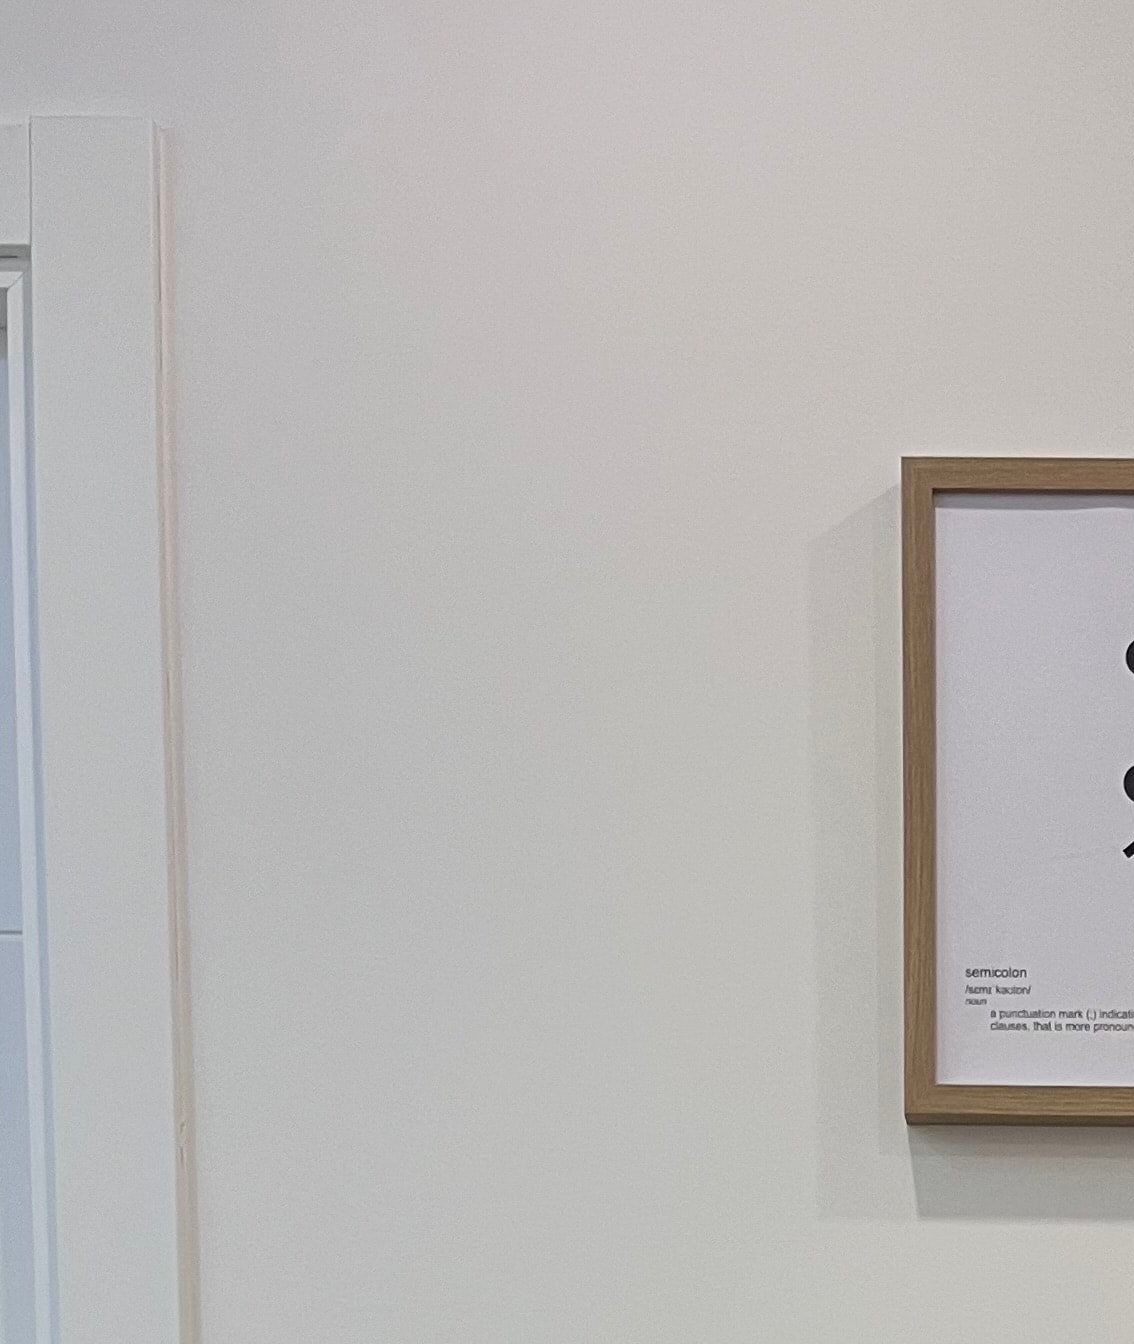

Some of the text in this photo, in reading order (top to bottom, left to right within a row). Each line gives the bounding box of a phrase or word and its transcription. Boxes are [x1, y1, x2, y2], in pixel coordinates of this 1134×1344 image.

[964, 966, 1028, 979] semicolon
[998, 1009, 1056, 1020] punctuation
[1058, 1009, 1084, 1019] mark
[1032, 1021, 1052, 1031] that
[1053, 1021, 1063, 1031] is
[1065, 1022, 1091, 1031] more
